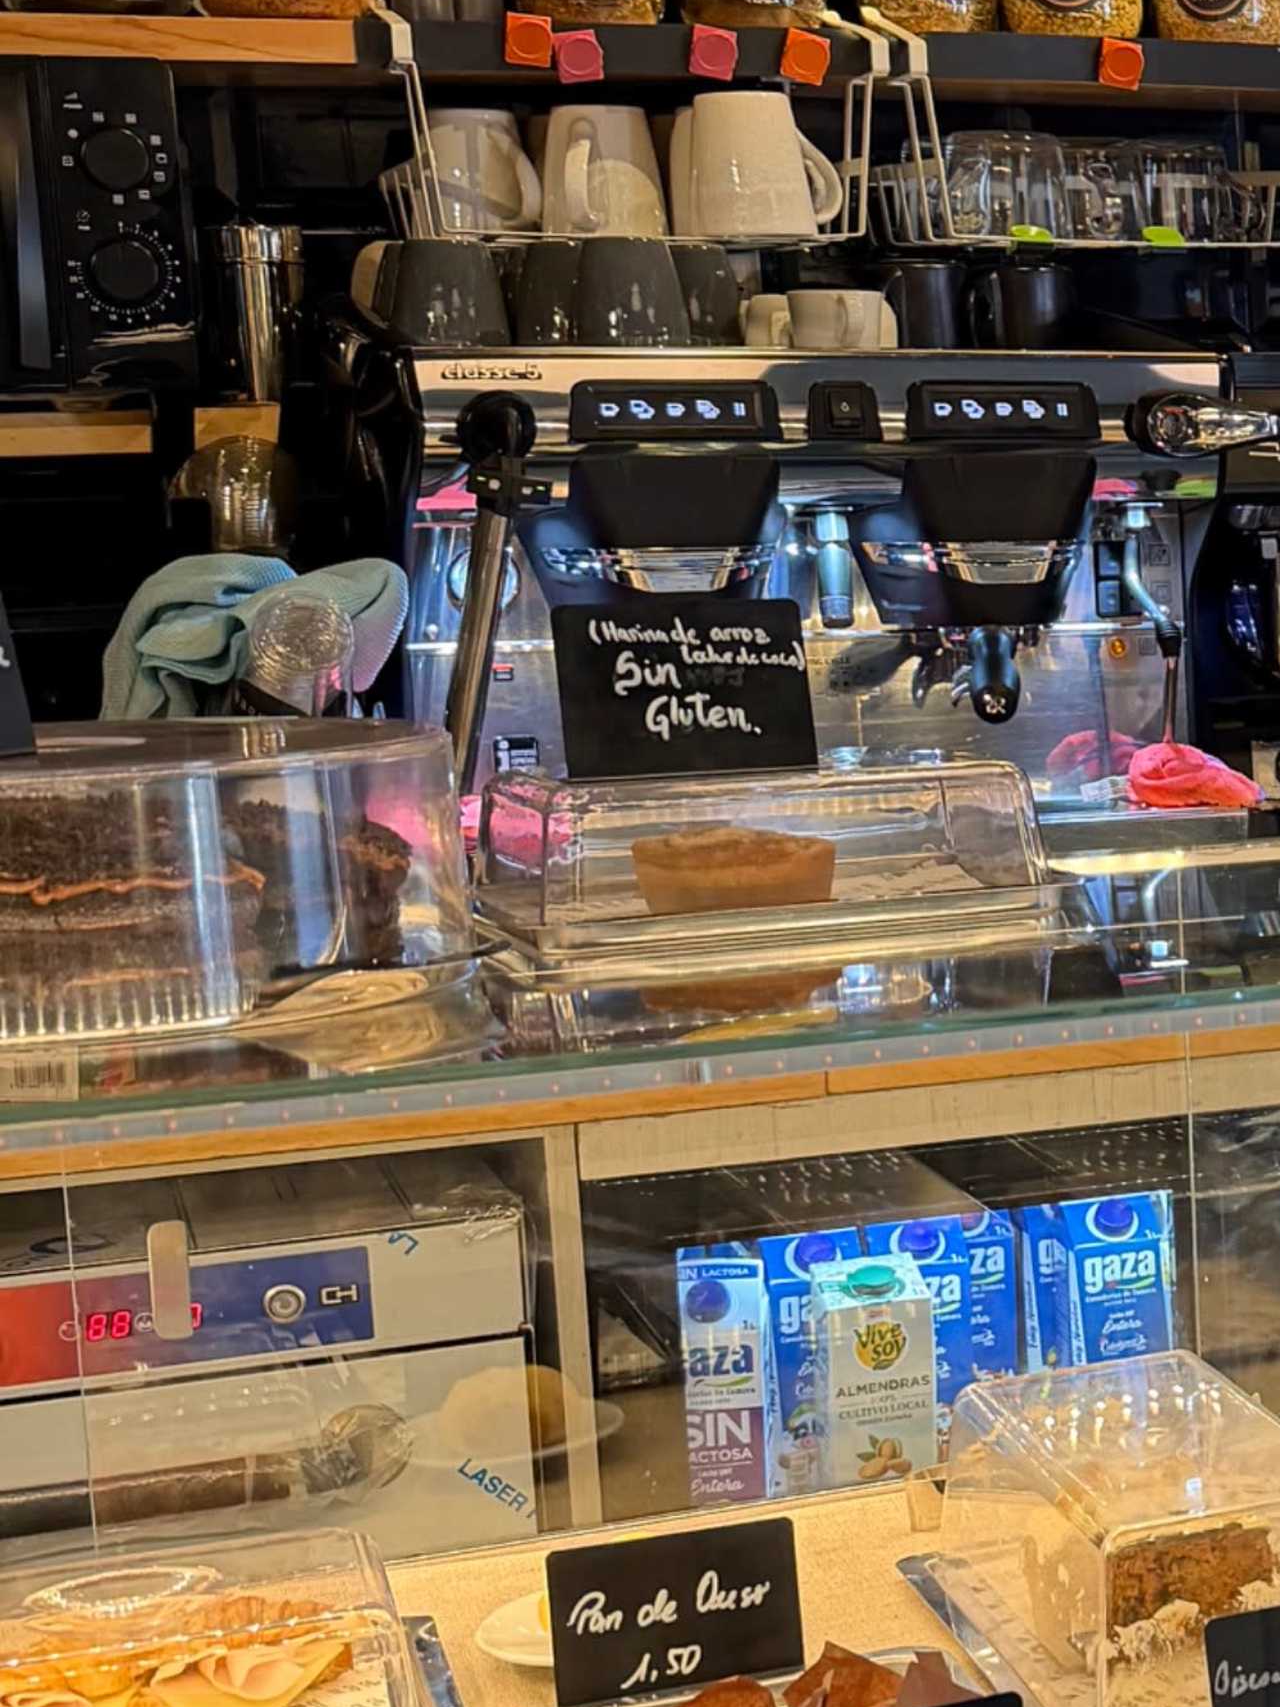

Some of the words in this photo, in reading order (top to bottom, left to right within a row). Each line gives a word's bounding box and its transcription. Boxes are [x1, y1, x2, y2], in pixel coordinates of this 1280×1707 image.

[709, 625, 771, 644] arroz
[614, 650, 682, 696] Sin
[702, 1267, 749, 1277] LACTOSA
[1083, 1250, 1156, 1294] gaza
[853, 1322, 902, 1348] Vive
[872, 1335, 908, 1363] soy
[835, 1375, 931, 1399] ALMENDRAS
[839, 1404, 887, 1421] CULTIVO
[890, 1400, 929, 1414] LOCAL
[686, 1410, 750, 1448] SIN
[456, 1457, 529, 1513] LASER
[567, 1590, 623, 1636] Pan
[636, 1588, 679, 1628] de
[695, 1569, 772, 1616] Queso
[619, 1643, 702, 1690] 1,50
